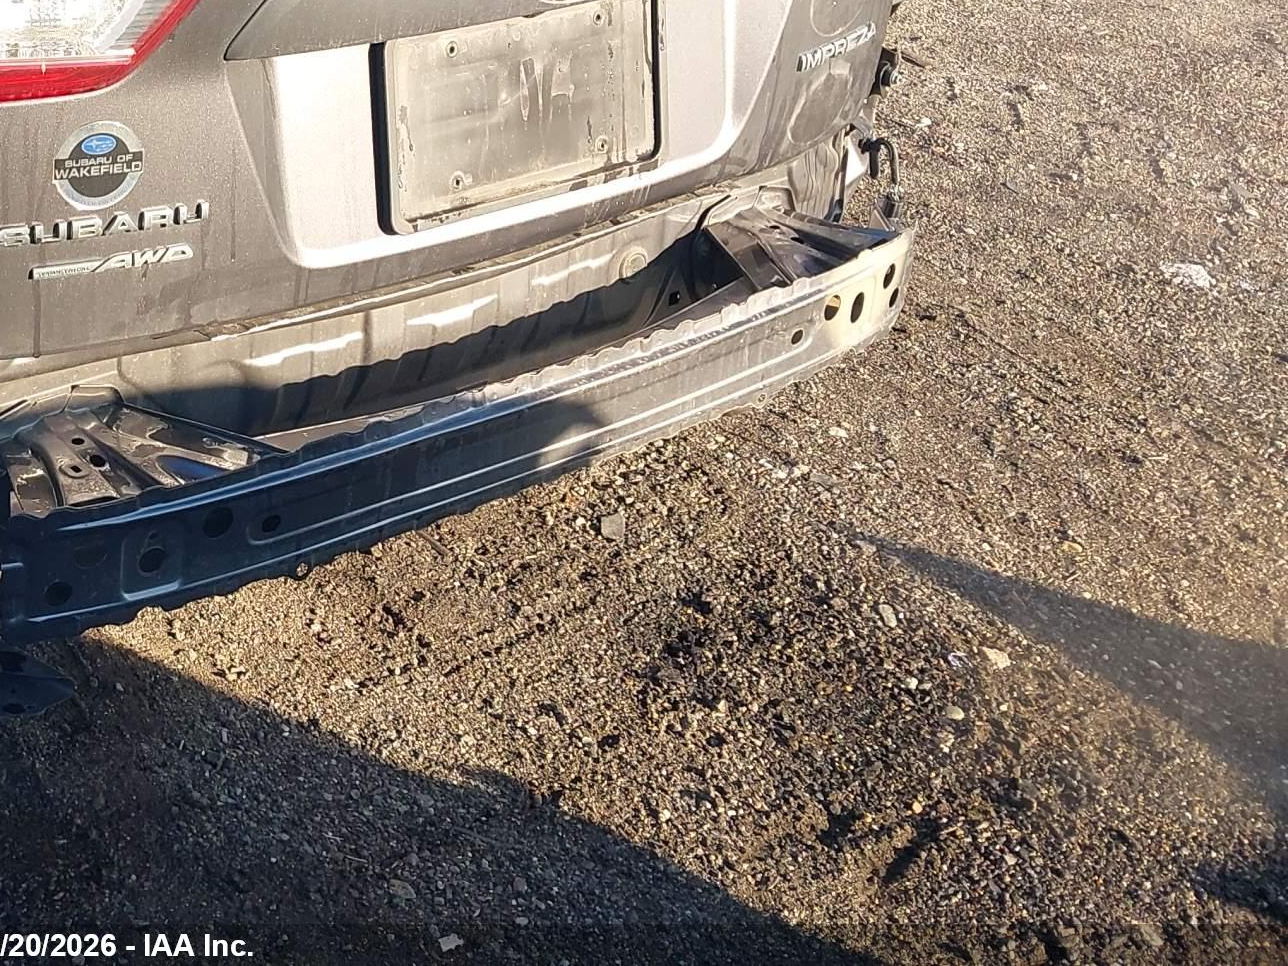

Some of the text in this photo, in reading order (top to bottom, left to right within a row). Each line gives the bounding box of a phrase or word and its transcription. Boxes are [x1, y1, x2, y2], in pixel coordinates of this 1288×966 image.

[55, 161, 142, 179] WAKEFIELD
[64, 154, 133, 168] SUBARU OF
[91, 243, 193, 273] AWD
